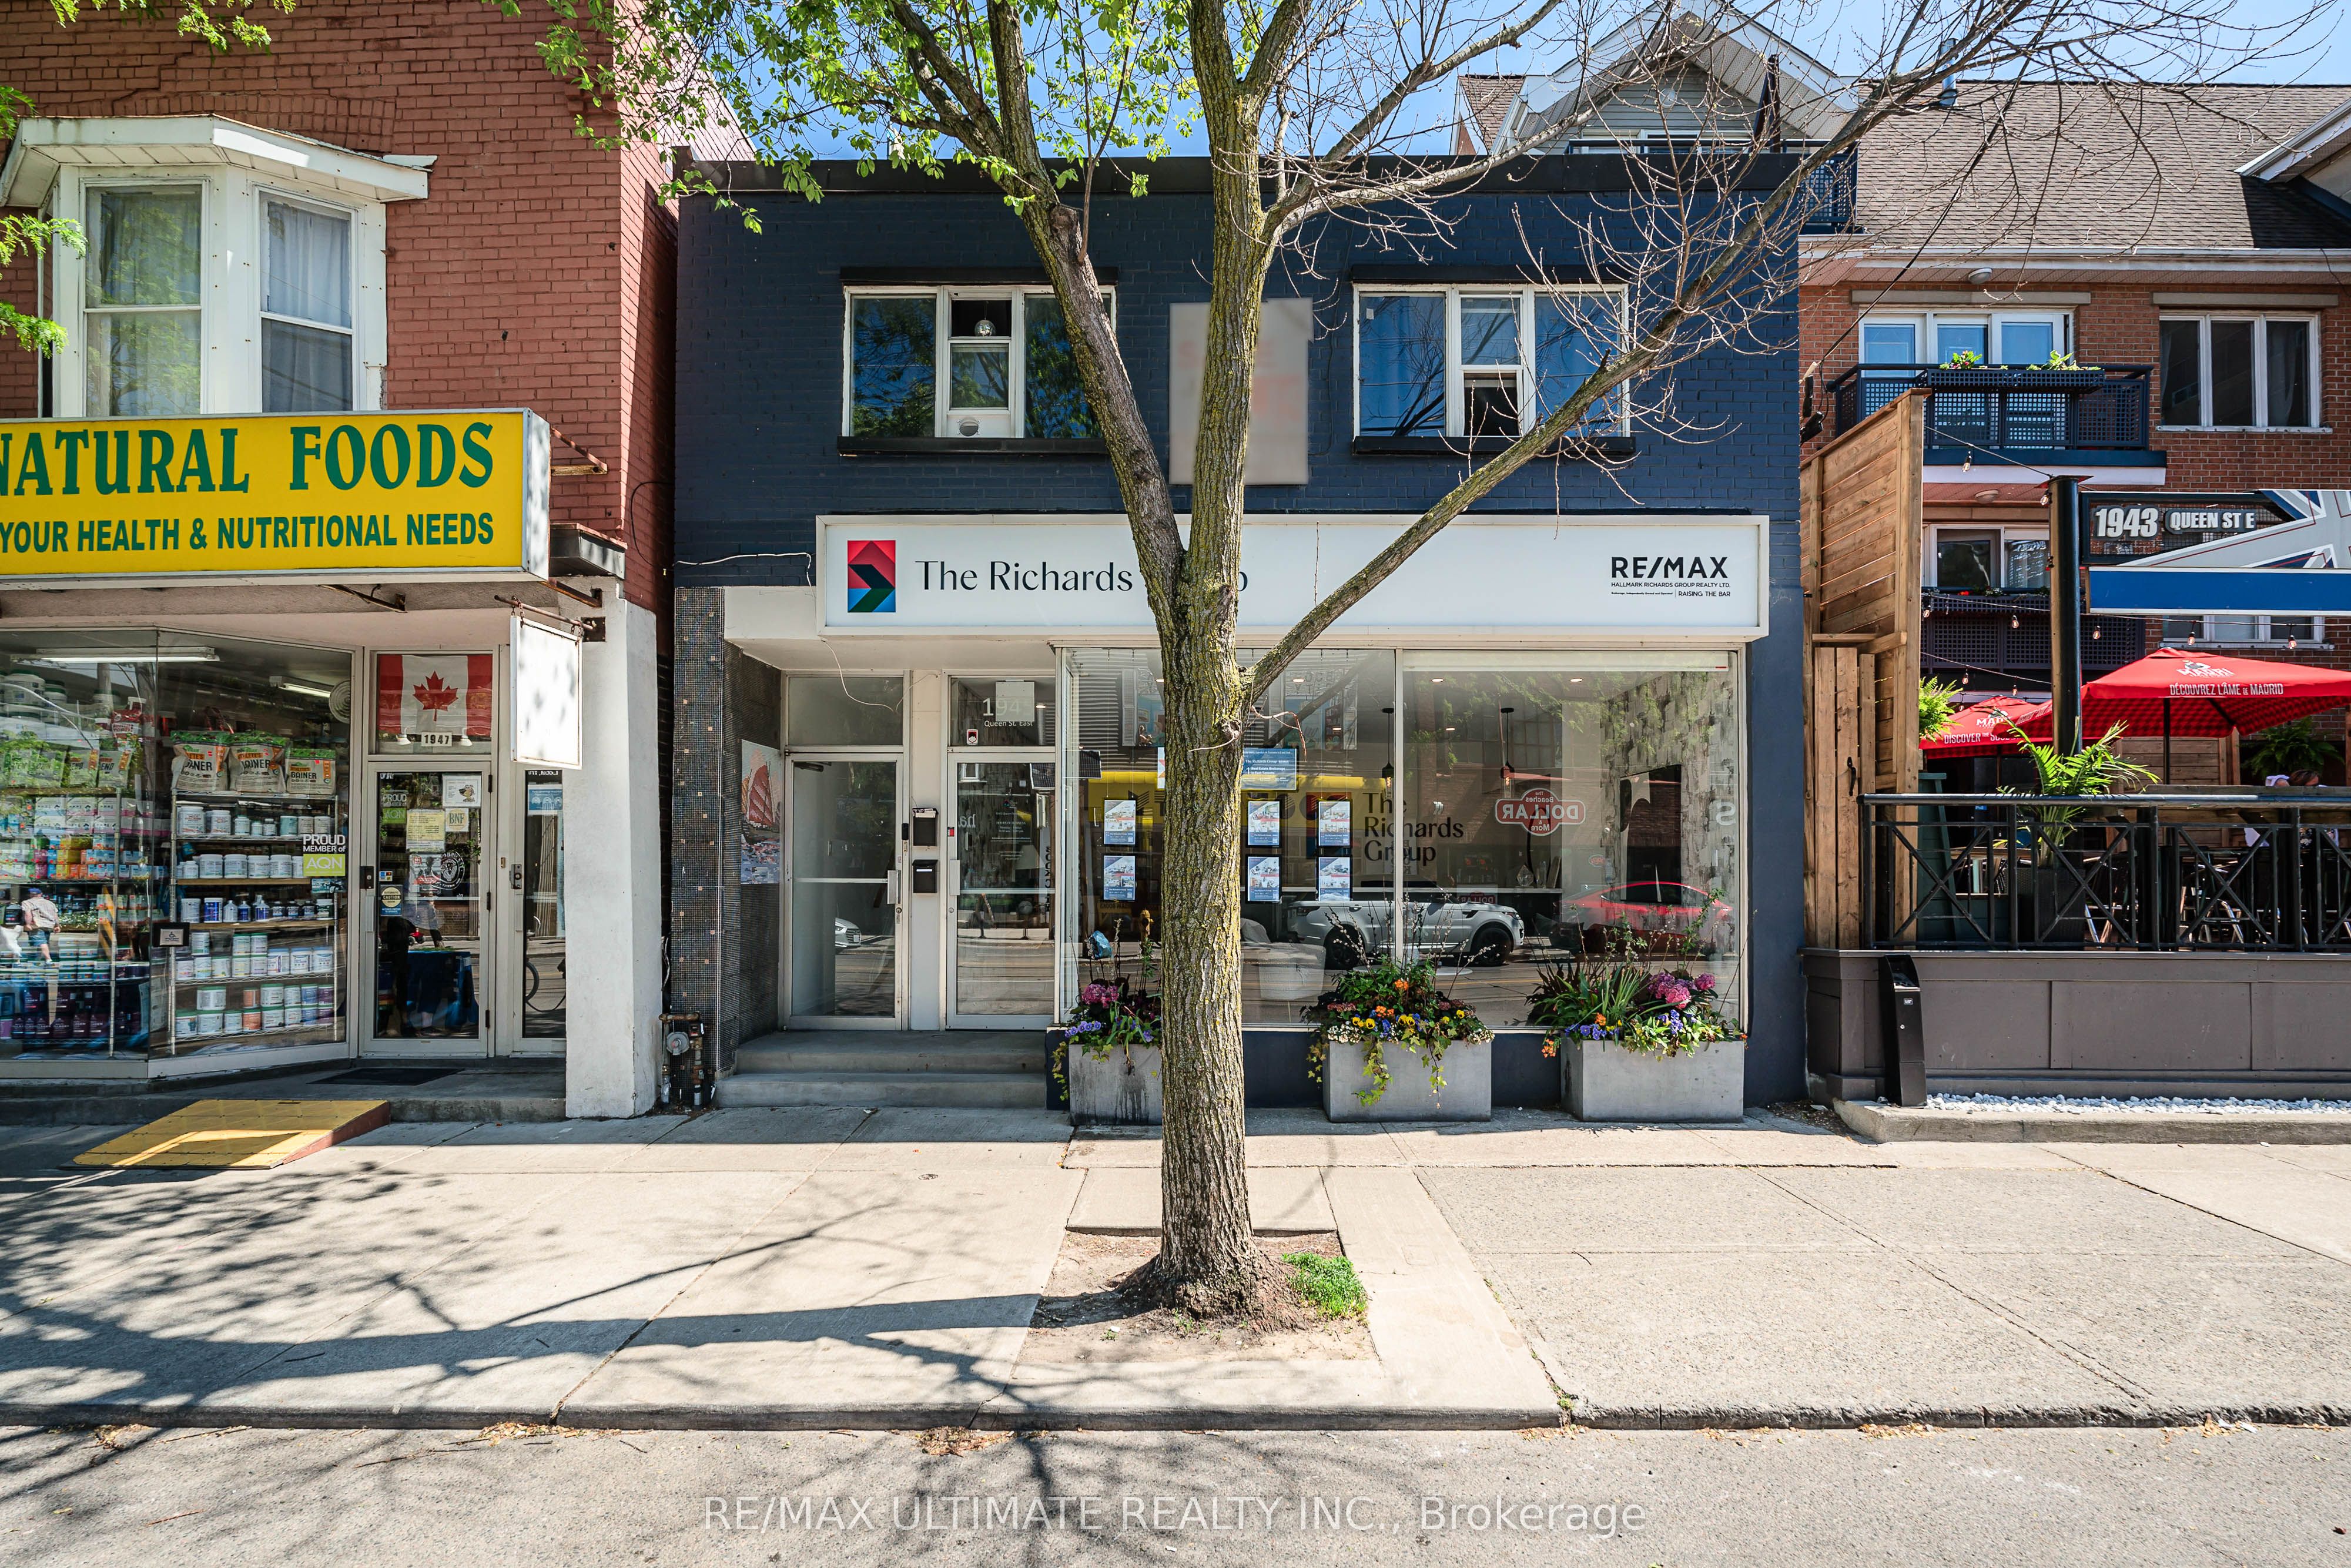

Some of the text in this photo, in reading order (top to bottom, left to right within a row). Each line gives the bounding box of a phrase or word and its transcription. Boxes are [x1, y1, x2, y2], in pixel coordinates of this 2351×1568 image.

[0, 422, 493, 496] ATURAL FOODS
[2095, 507, 2255, 537] 1943 QUEEN ST E
[0, 512, 494, 553] YOUR HEALTH & NUTRITIONAL NEEDS
[1611, 557, 1728, 578] RE/MAX
[915, 560, 1133, 592] The Richards
[2169, 682, 2215, 695] DÉCOUVREZ
[2250, 683, 2284, 695] MADRID
[983, 698, 1033, 716] 194
[424, 734, 450, 745] 1947
[1944, 732, 1981, 744] DISCOVER
[291, 771, 317, 779] GAINER
[383, 793, 407, 802] PROUD
[449, 813, 465, 824] BNF
[303, 834, 346, 845] PROUD
[306, 856, 343, 869] AQN
